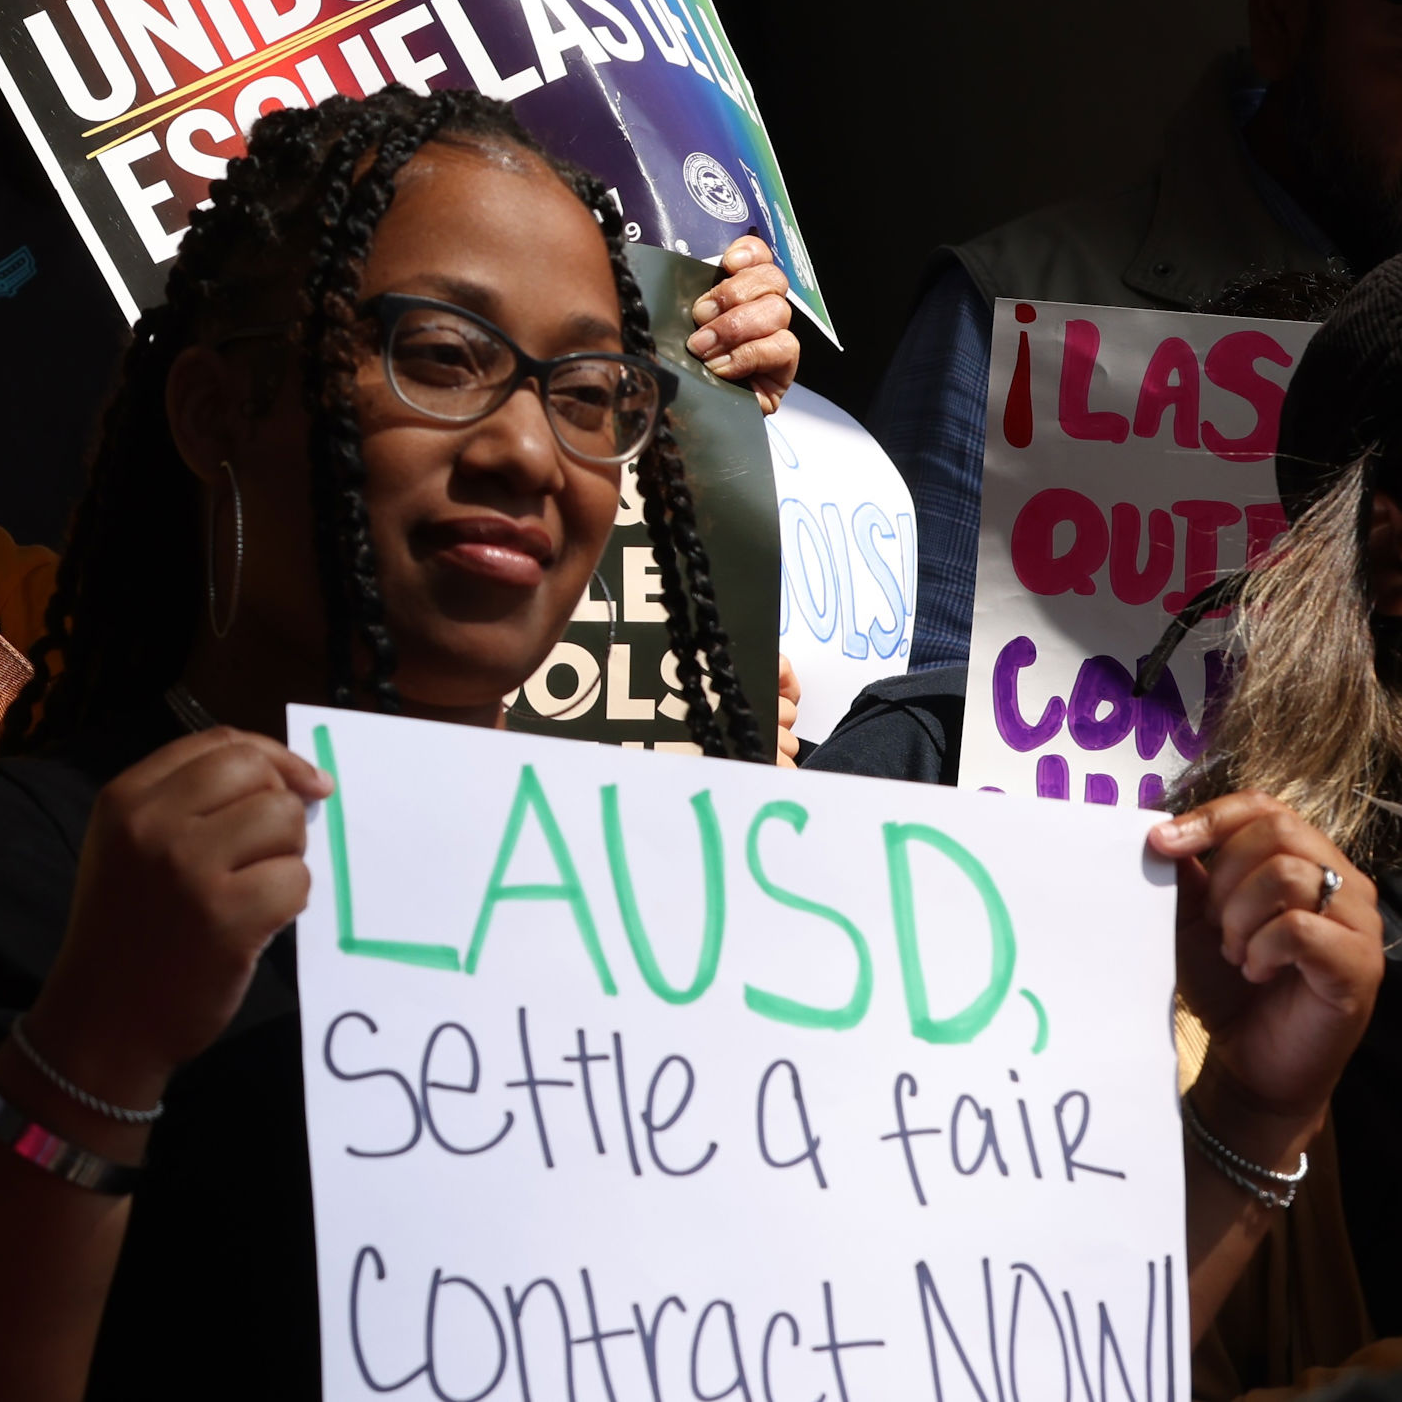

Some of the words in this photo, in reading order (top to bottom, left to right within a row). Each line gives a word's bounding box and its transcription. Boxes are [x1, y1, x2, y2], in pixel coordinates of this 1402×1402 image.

[1003, 302, 1294, 463] ¡LAS
[779, 497, 915, 660] OLS!
[503, 641, 722, 722] OLS
[313, 724, 1049, 1055] LAUSD,
